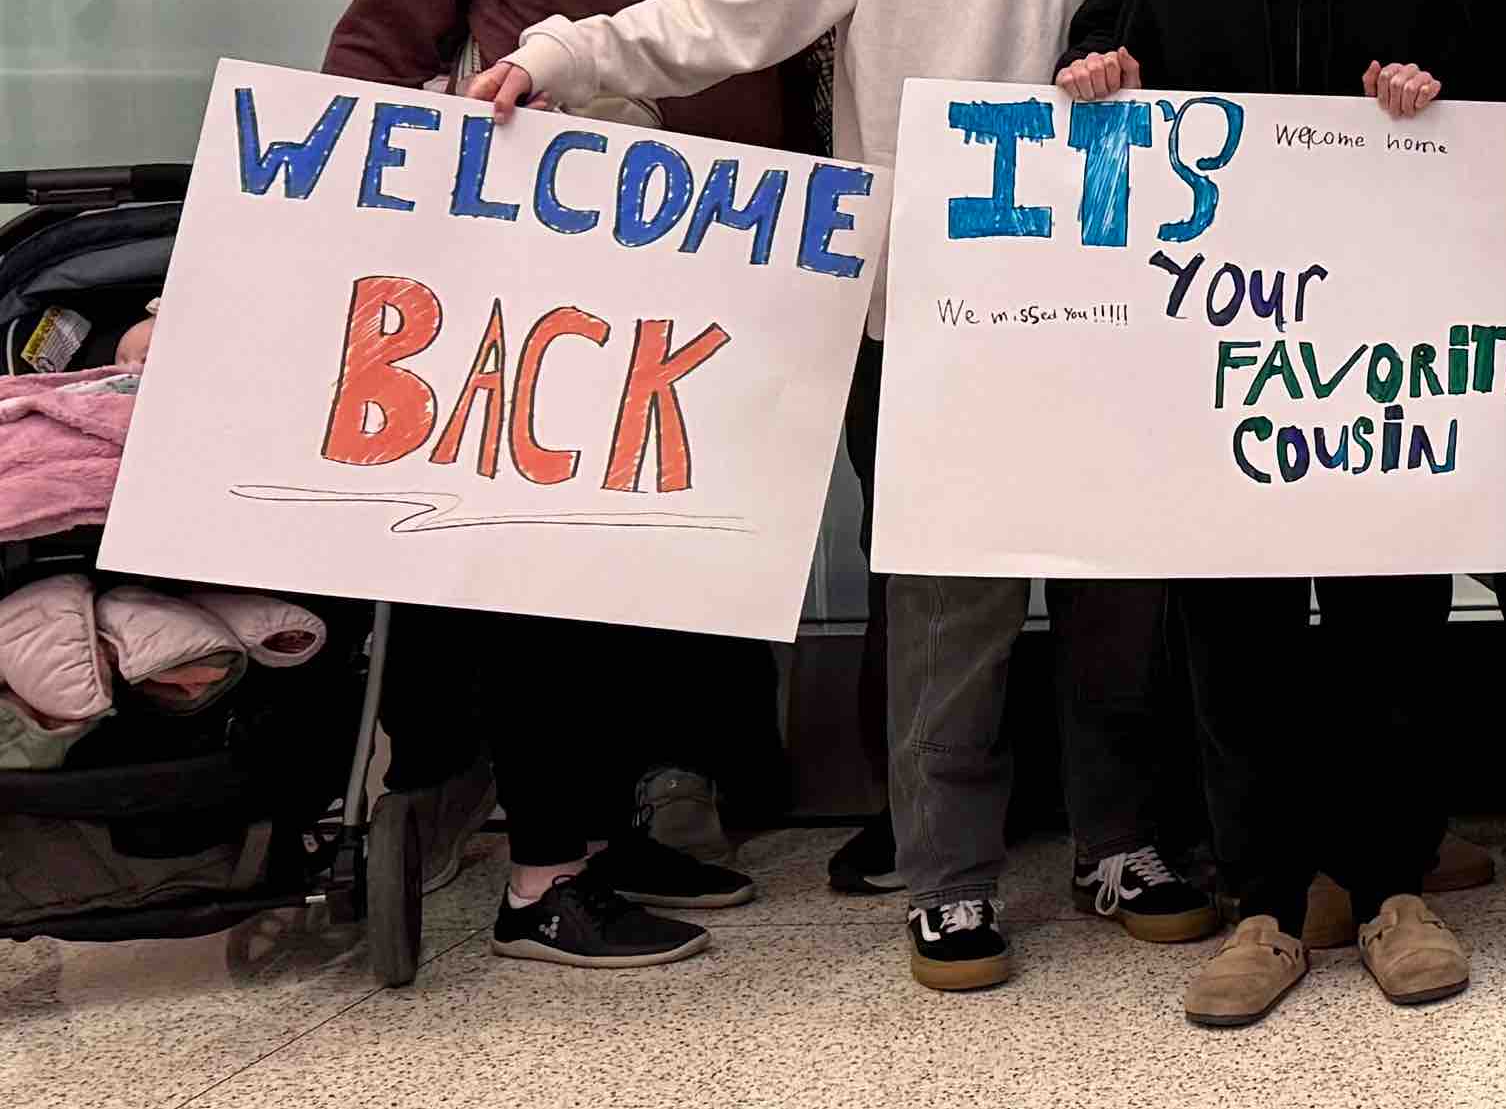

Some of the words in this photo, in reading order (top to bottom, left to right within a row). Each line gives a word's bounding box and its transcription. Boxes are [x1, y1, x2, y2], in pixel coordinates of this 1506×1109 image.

[234, 87, 874, 279] WELCOME
[1386, 133, 1449, 154] home
[937, 298, 981, 326] We
[321, 276, 733, 494] BACK
